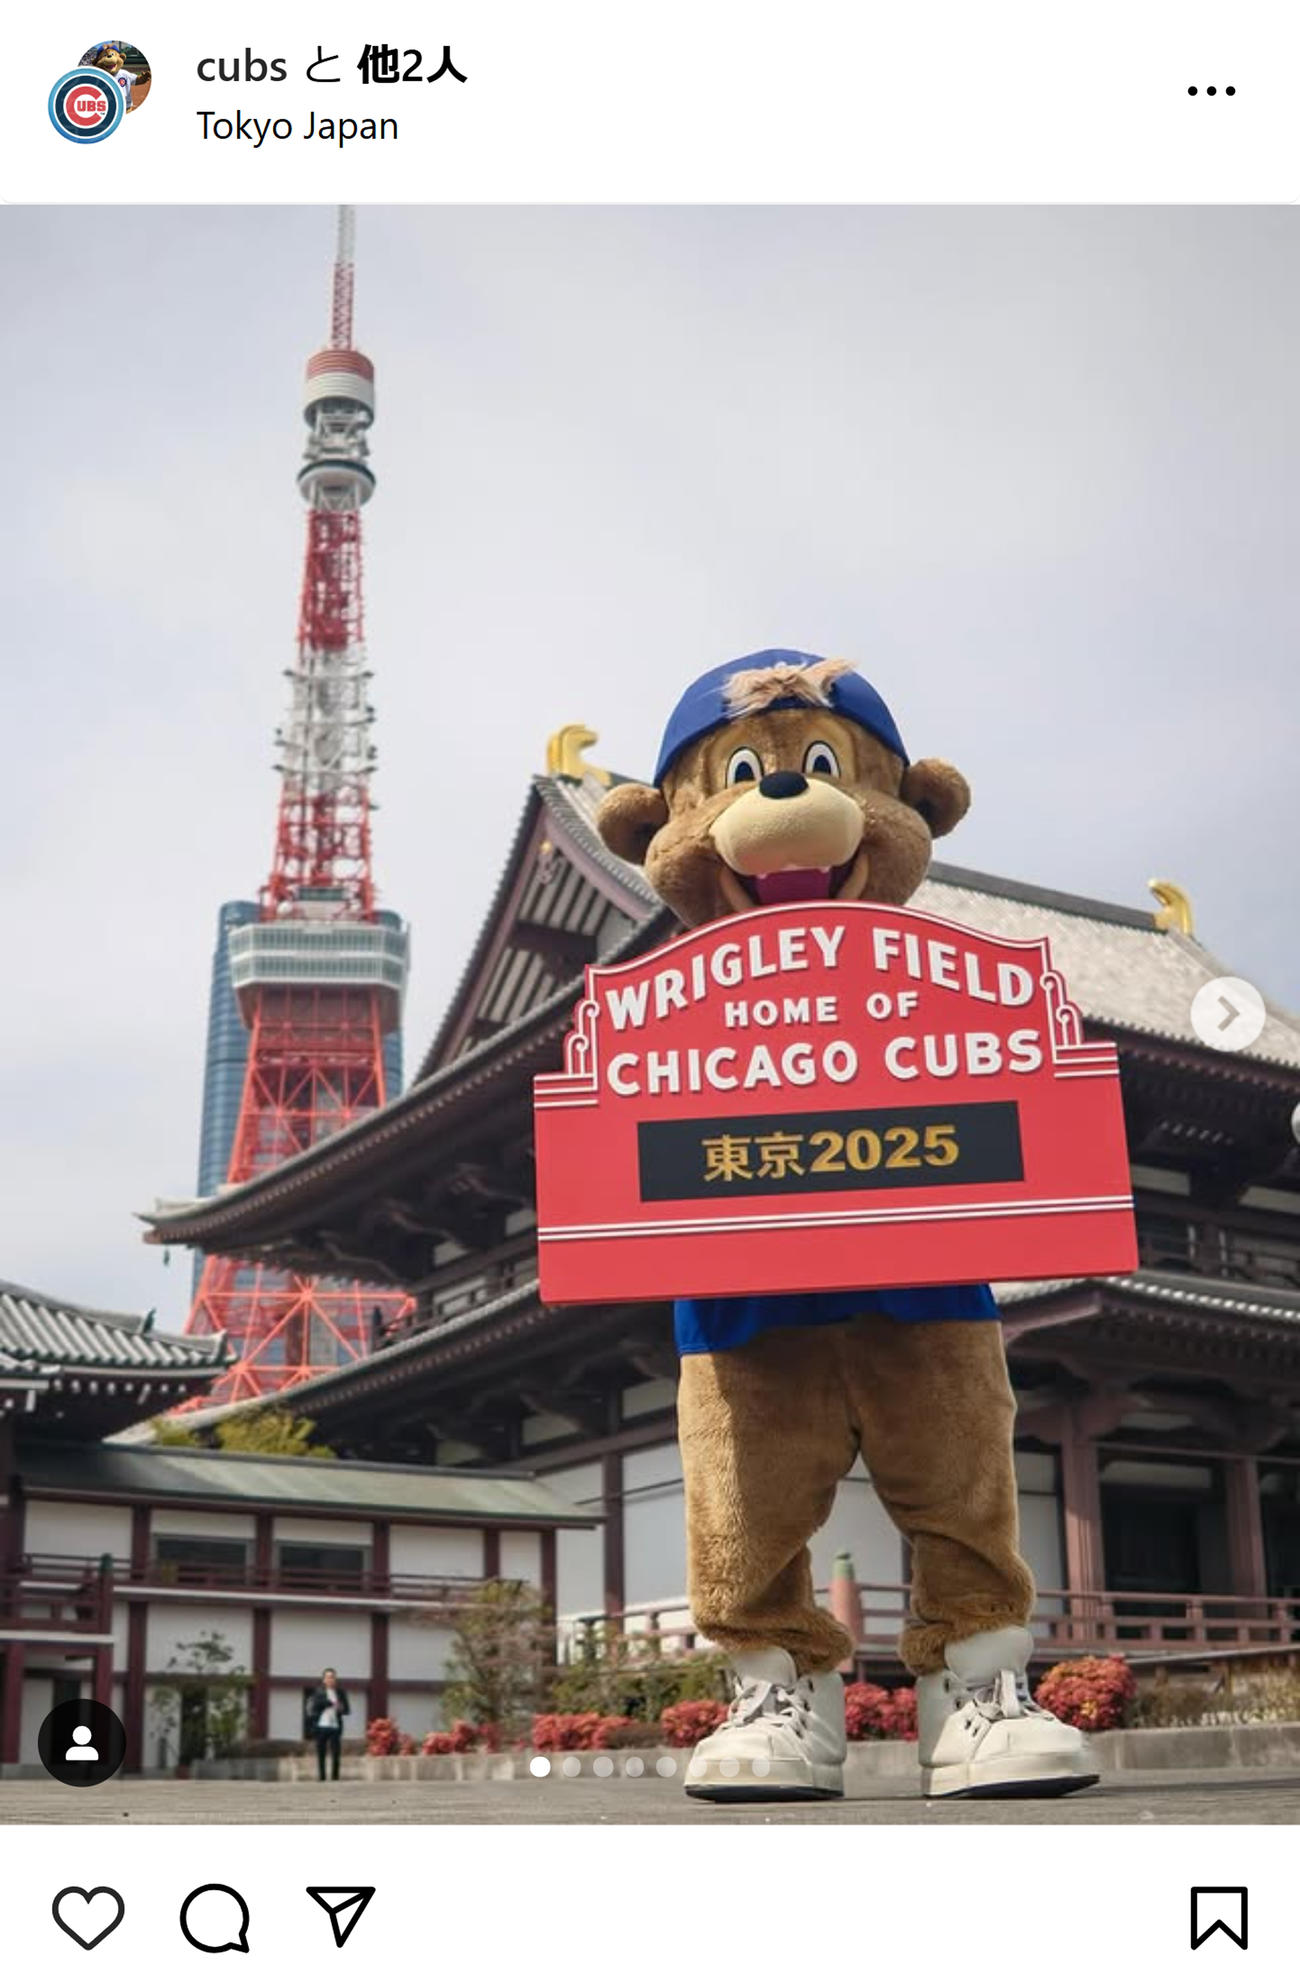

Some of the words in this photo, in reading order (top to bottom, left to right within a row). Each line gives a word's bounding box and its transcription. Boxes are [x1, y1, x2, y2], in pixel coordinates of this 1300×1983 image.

[605, 926, 845, 1030] WRIGLEY
[872, 927, 1033, 1008] FIELD
[725, 996, 838, 1027] HOME
[866, 991, 918, 1018] OF
[607, 1040, 859, 1095] CHICAGO
[885, 1029, 1043, 1080] CUBS
[701, 1125, 960, 1182] 東京2025
